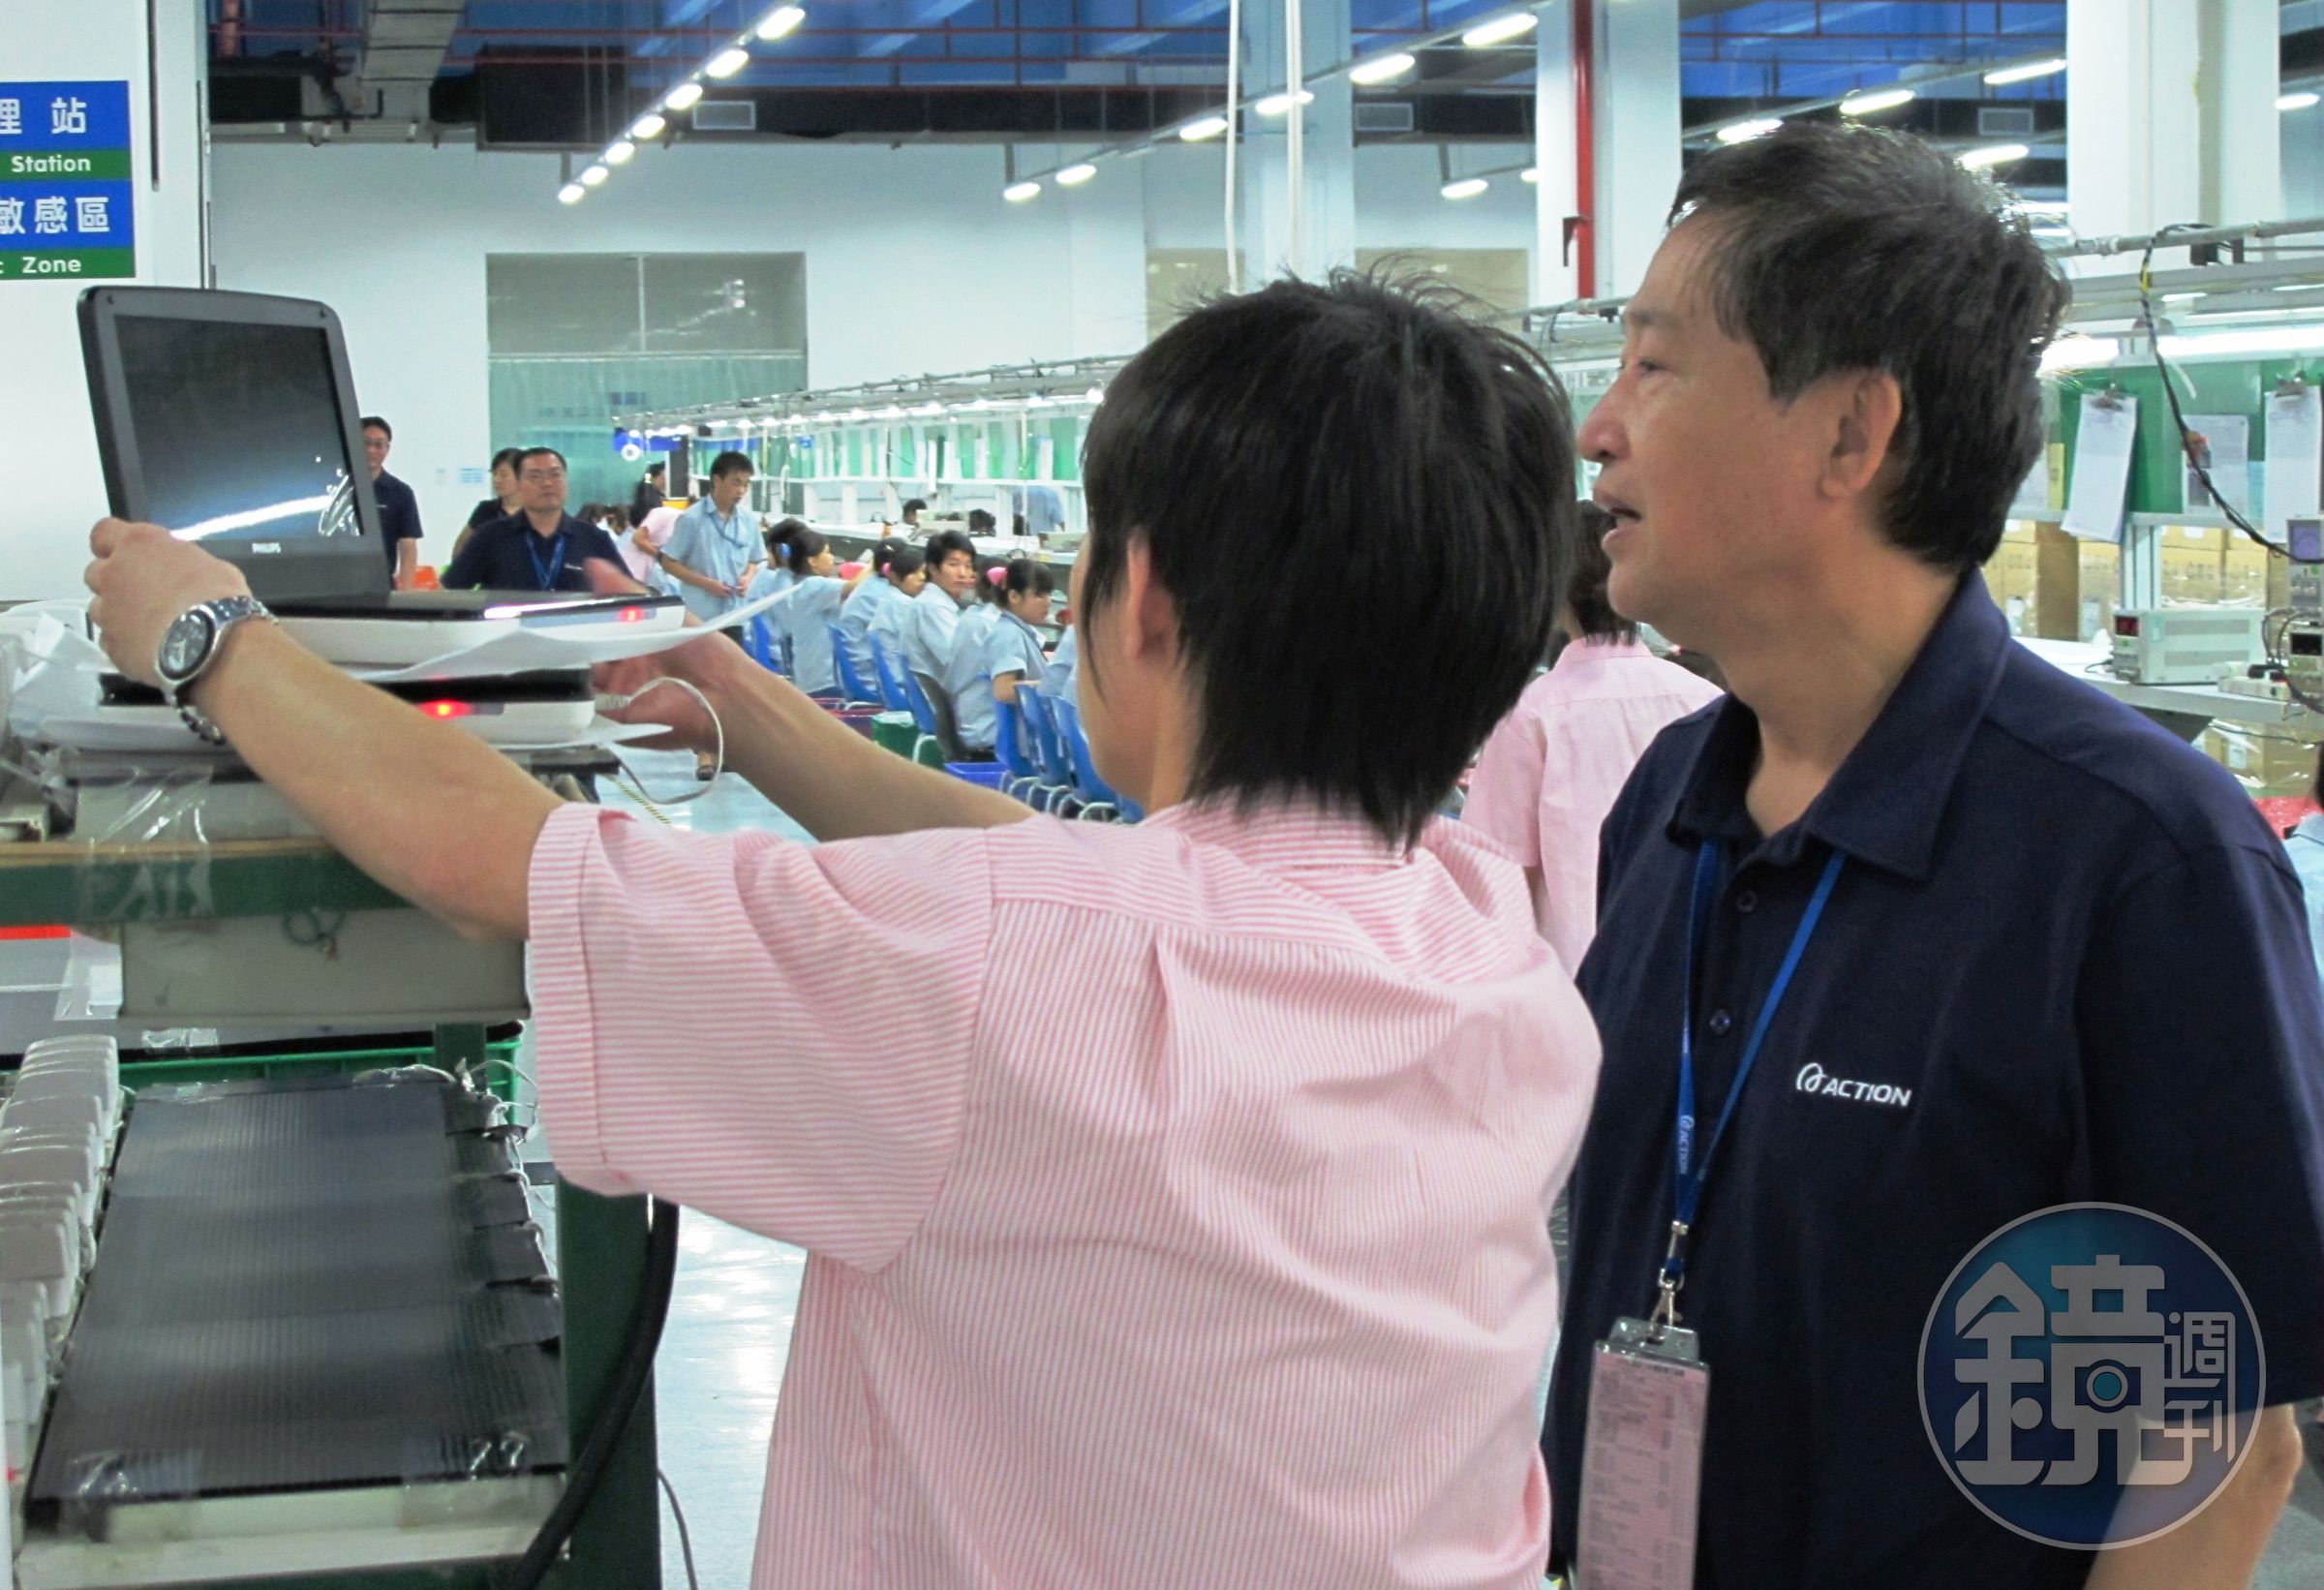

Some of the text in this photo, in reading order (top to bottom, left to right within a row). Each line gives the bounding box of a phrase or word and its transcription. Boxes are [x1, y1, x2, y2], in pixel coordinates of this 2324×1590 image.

[12, 155, 91, 172] Station
[22, 257, 81, 273] Zone
[1821, 1078, 1912, 1106] ACTION
